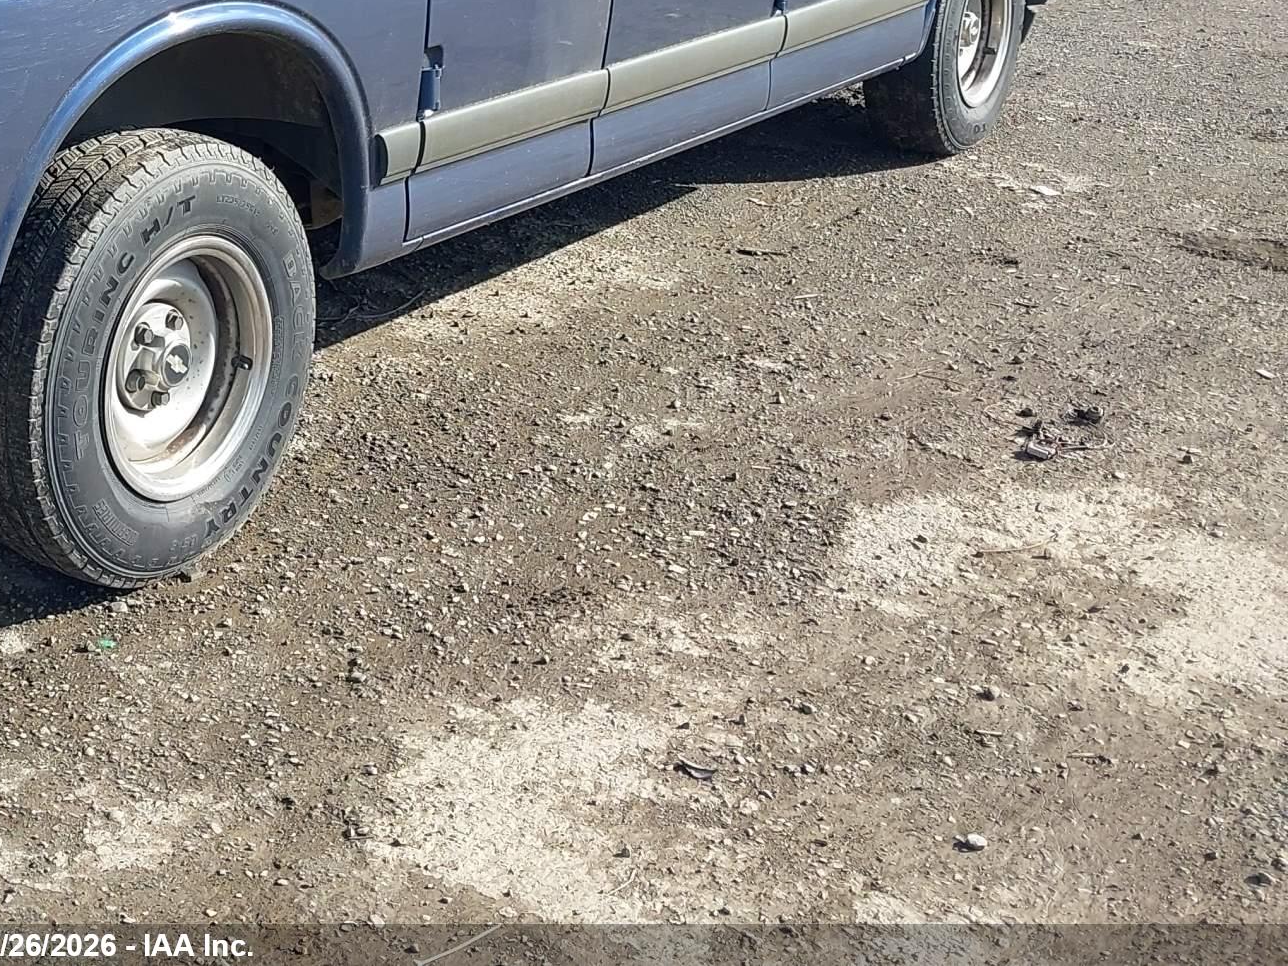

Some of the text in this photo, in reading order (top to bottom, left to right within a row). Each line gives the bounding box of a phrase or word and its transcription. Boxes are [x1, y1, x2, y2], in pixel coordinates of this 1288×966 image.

[140, 194, 196, 247] H/T
[282, 251, 305, 359] BACK
[204, 374, 300, 538] COUNTRY
